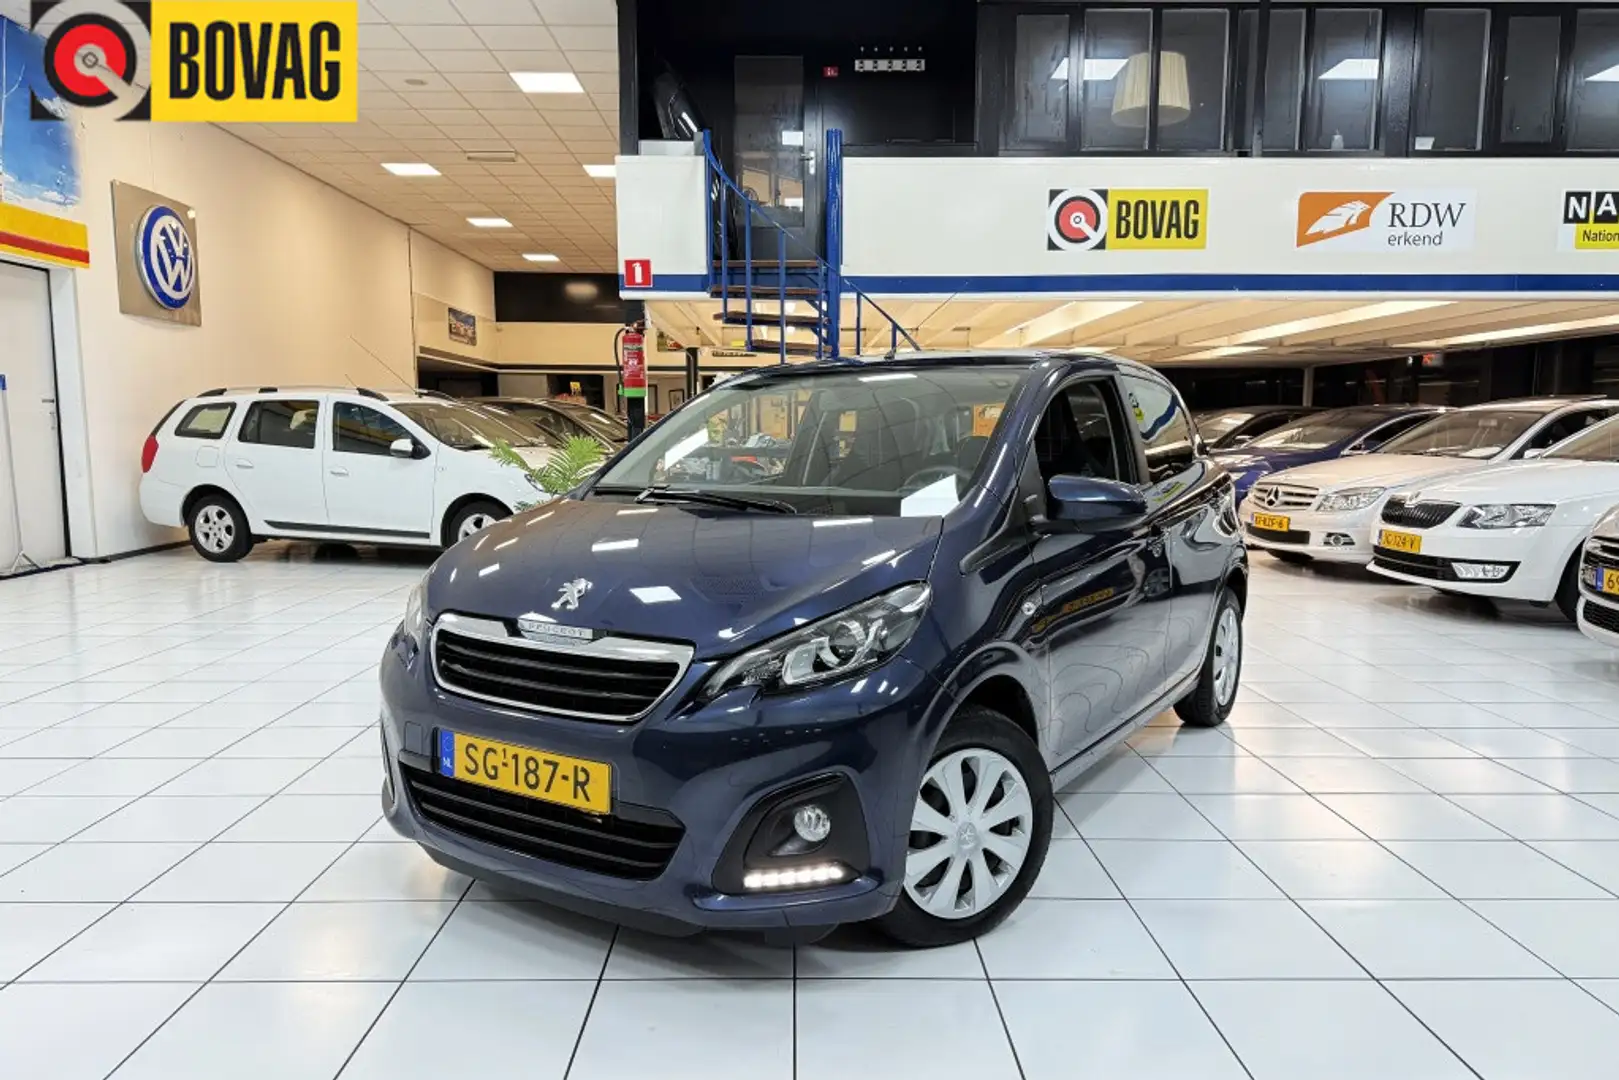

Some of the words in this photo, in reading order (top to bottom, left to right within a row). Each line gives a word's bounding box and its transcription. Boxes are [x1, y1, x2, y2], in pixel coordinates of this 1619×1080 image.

[1115, 199, 1200, 240] BOVAG
[1387, 202, 1467, 228] RDW
[1387, 231, 1443, 247] erkend
